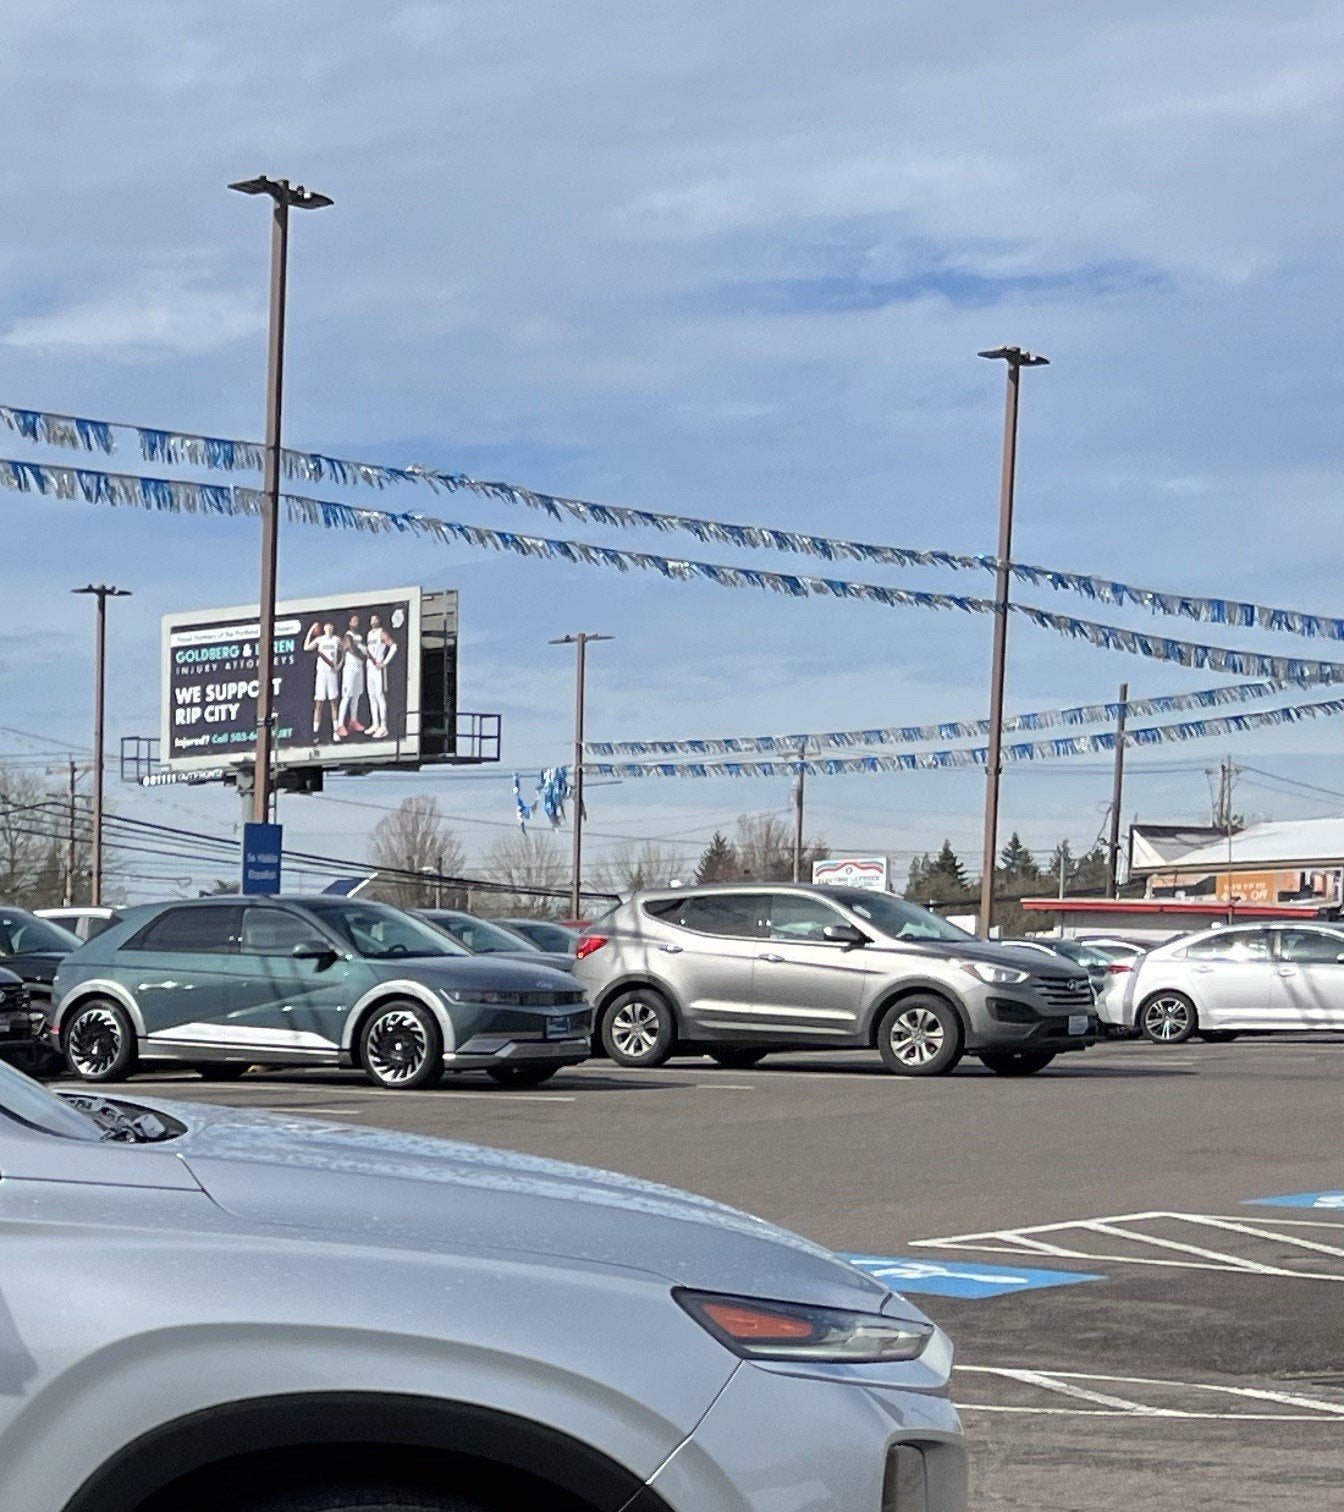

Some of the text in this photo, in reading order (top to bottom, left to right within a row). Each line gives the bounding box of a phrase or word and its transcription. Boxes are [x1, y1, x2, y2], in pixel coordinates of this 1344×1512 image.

[175, 644, 240, 664] GOLDBERG
[242, 643, 253, 657] &
[175, 654, 295, 676] INJURY ATTOEYS
[175, 677, 282, 705] WE SUPPOT
[175, 703, 240, 725] RIP CITY
[212, 732, 229, 744] Call
